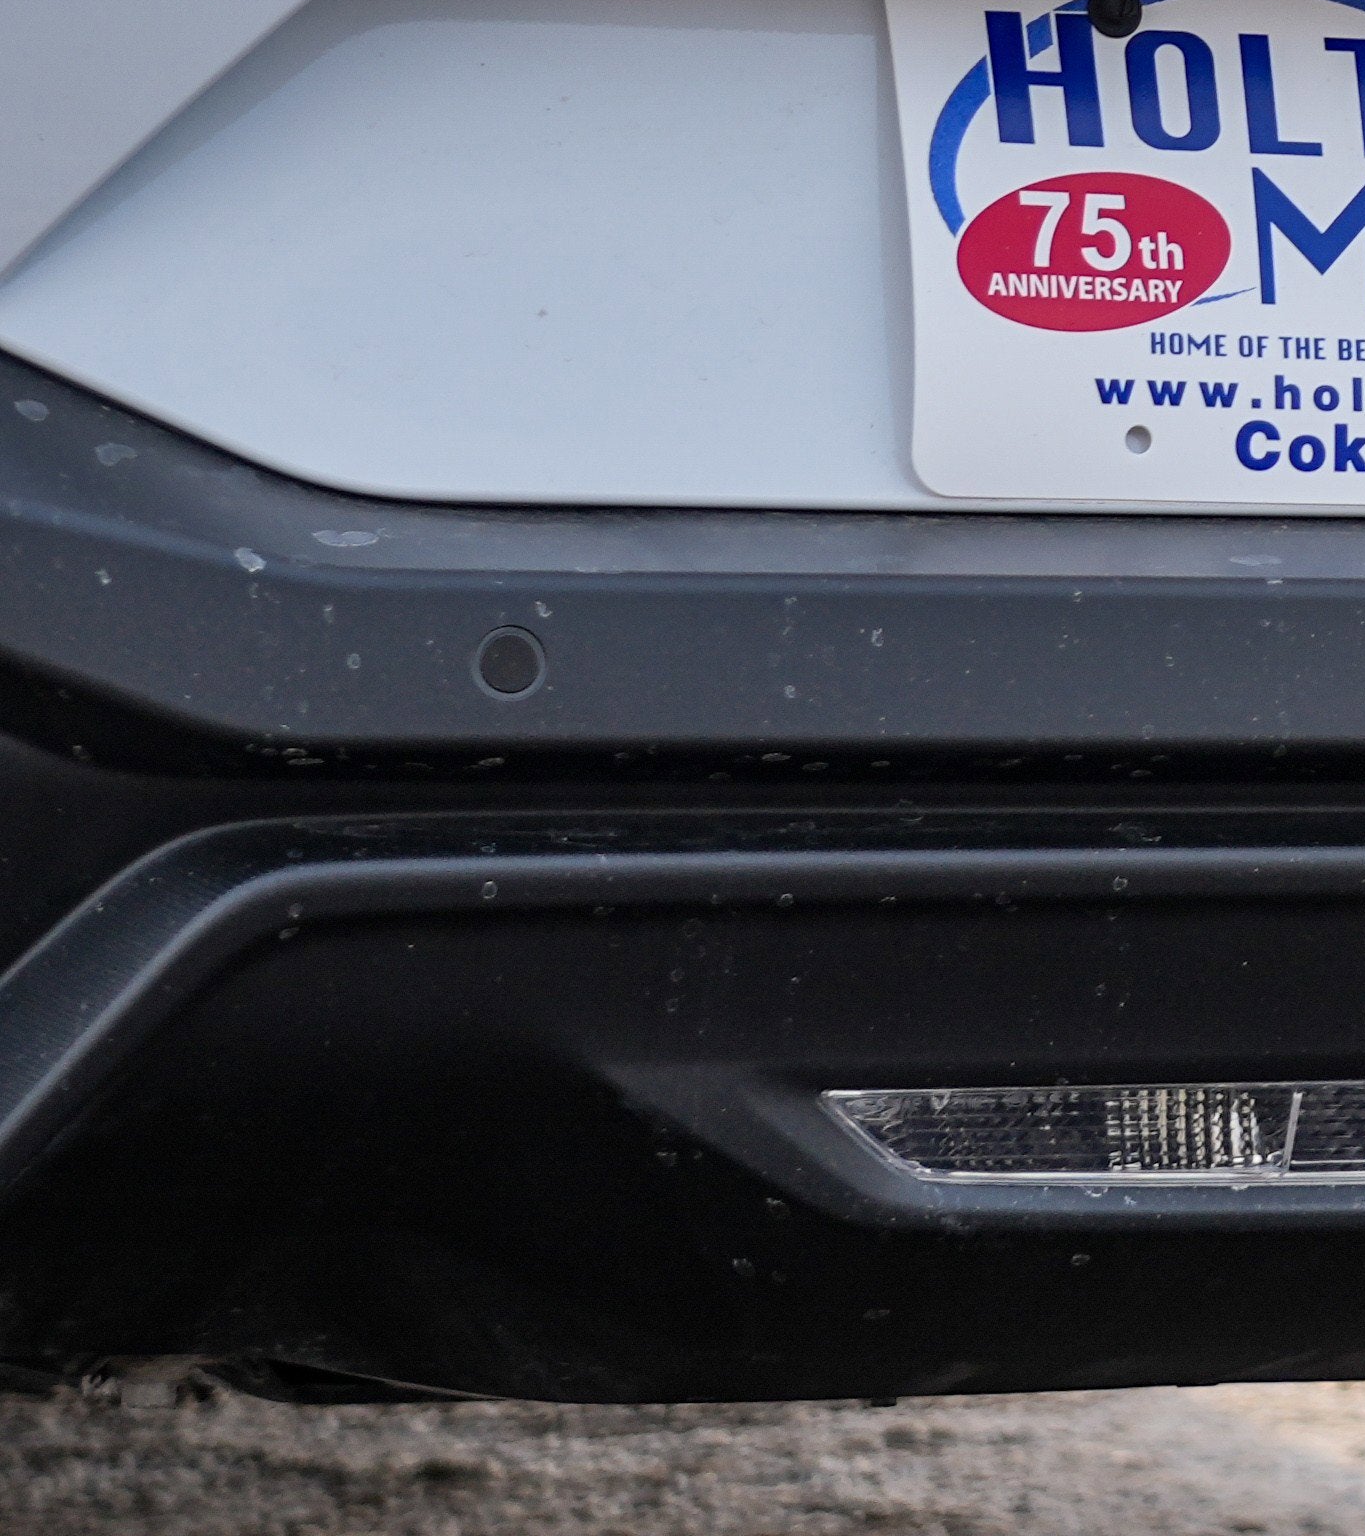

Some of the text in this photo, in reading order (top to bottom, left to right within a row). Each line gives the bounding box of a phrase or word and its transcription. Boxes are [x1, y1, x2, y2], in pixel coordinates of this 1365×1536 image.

[1019, 190, 1184, 272] 75th
[988, 272, 1183, 303] ANNIVERSARY
[1150, 332, 1227, 357] HOME
[1239, 335, 1269, 358] OF
[1279, 336, 1326, 360] THE
